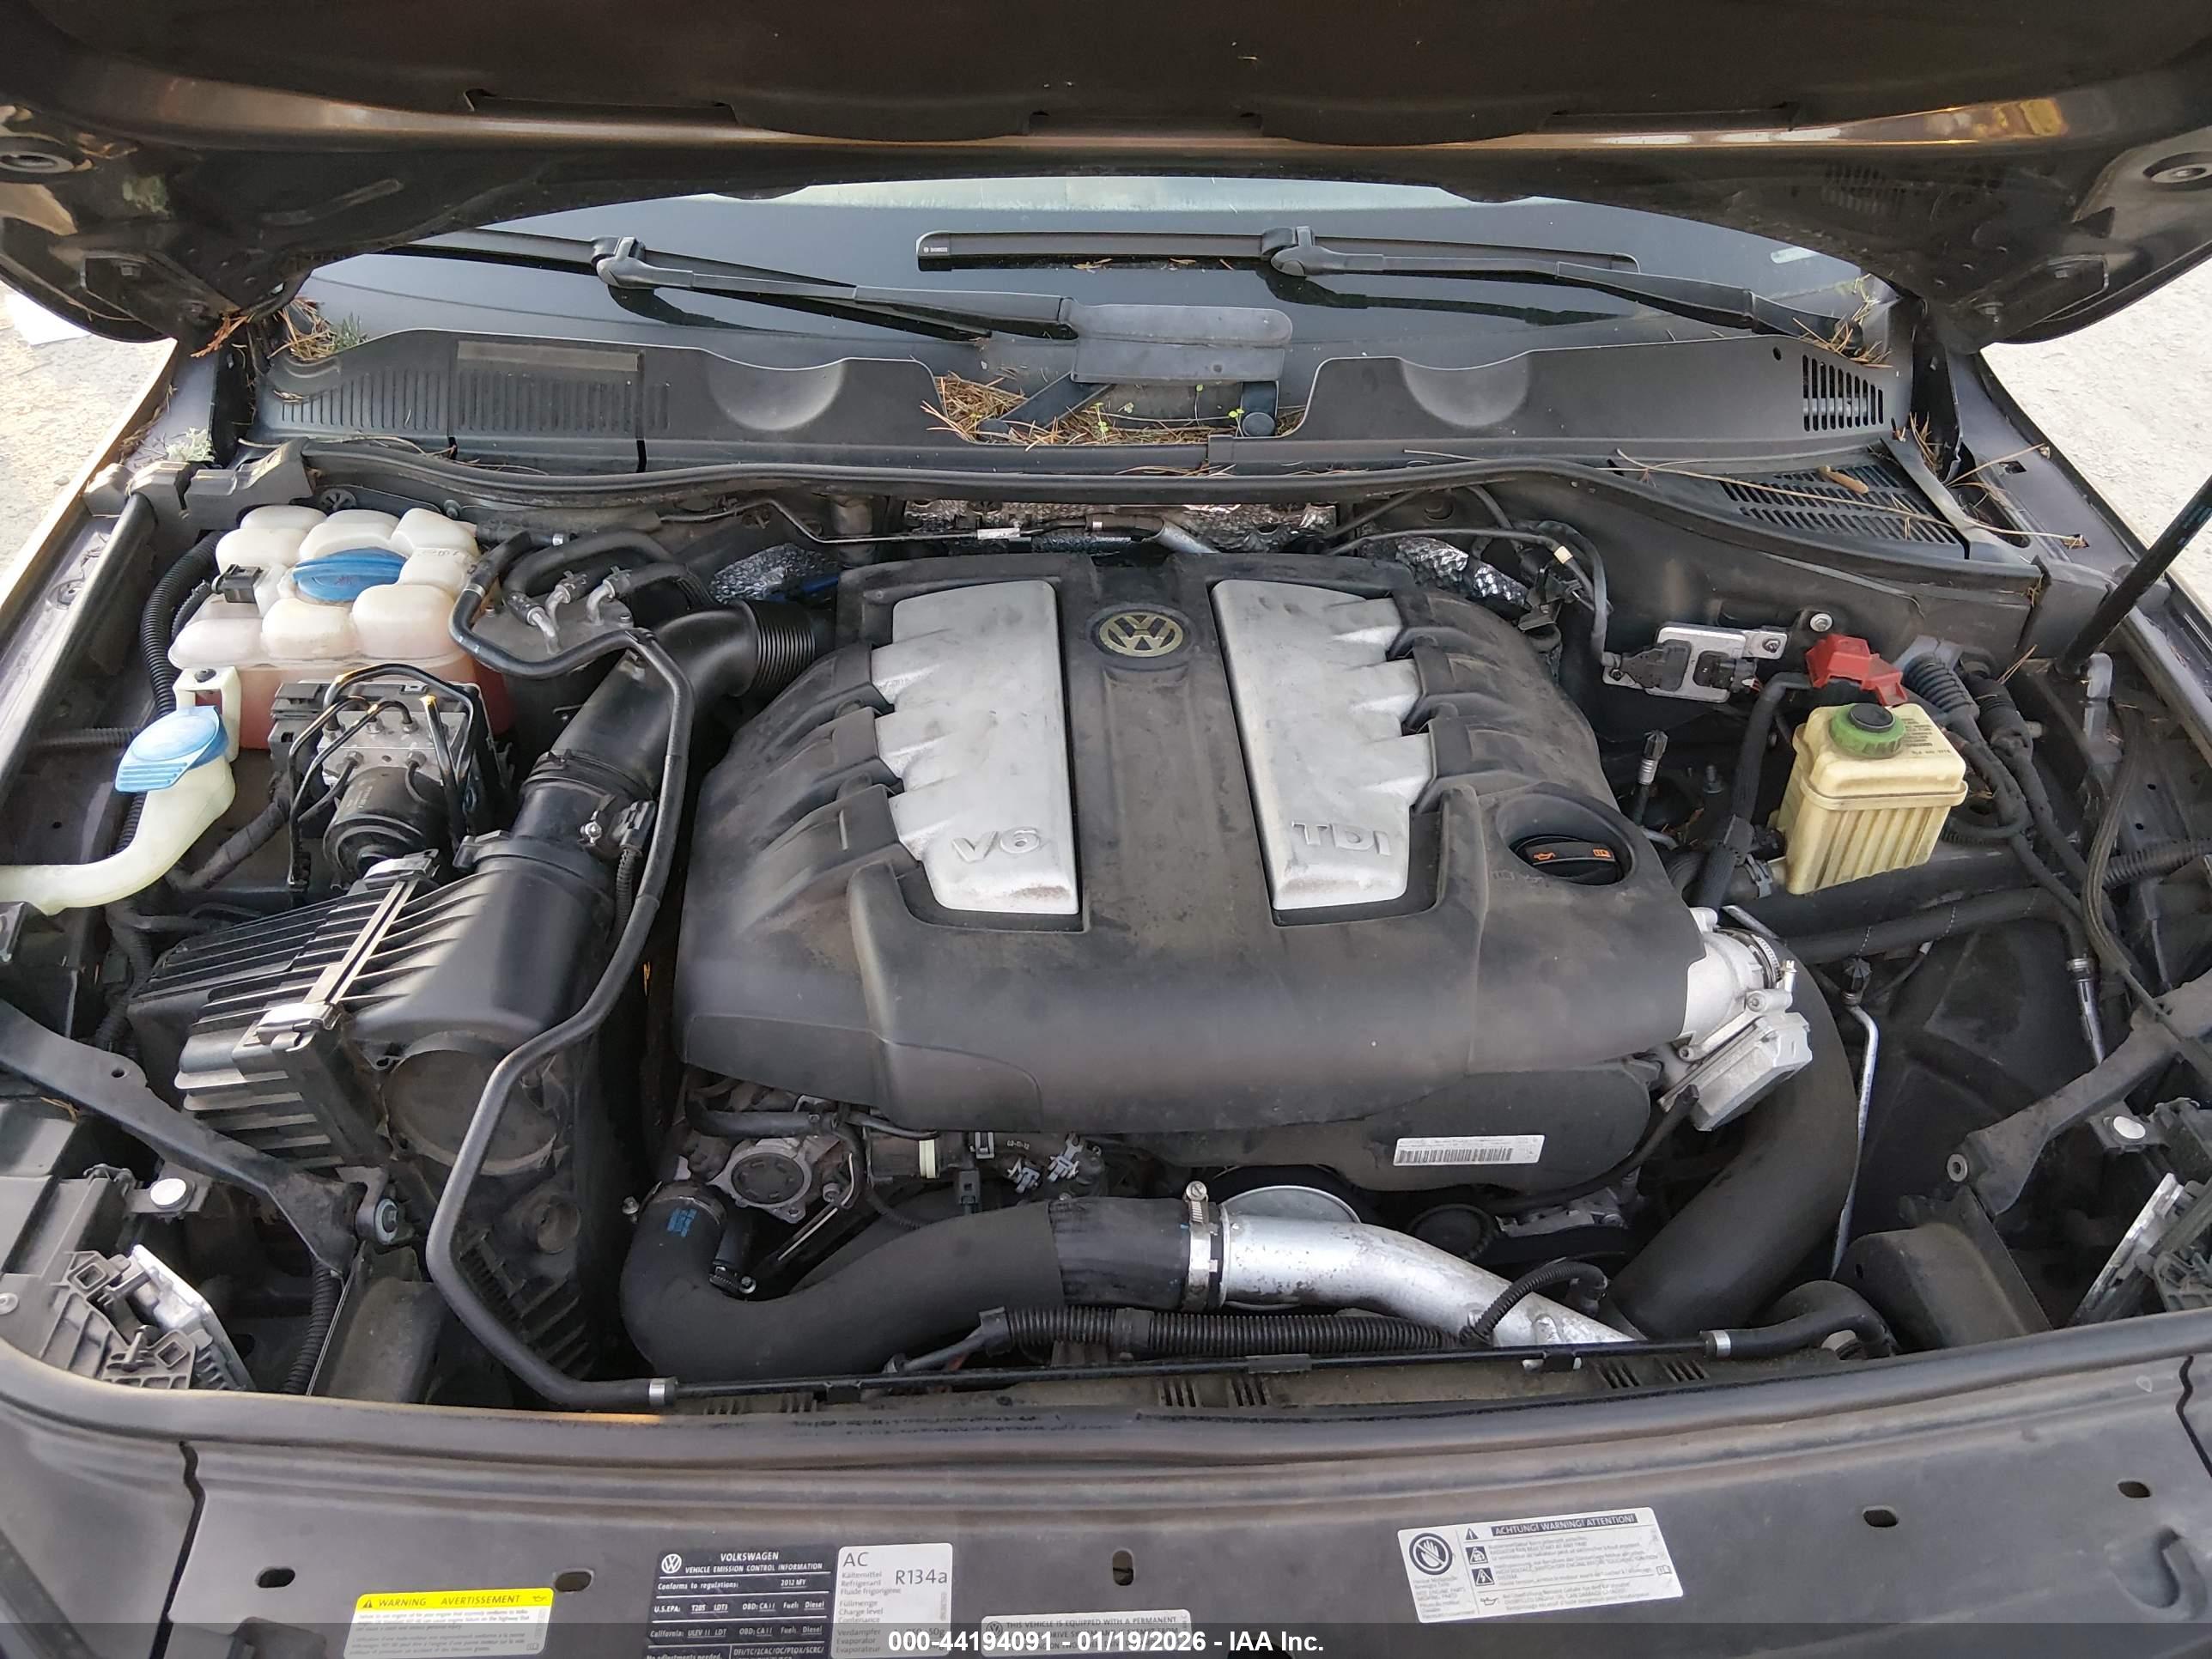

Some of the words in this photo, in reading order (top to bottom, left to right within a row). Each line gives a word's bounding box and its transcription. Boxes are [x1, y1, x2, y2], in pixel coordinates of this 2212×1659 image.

[1291, 820, 1391, 856] TDI
[950, 826, 1041, 864] V6
[1495, 1523, 1540, 1535] ACHTUNG!
[1540, 1519, 1584, 1530] WARNING!
[1586, 1515, 1634, 1526] ATTENTION!
[720, 1552, 779, 1562] VOLKSWAGEN
[842, 1552, 869, 1567] AC
[685, 1565, 710, 1574] VEHICLE
[714, 1565, 744, 1573] EMISSION
[746, 1564, 775, 1572] CONTROL
[778, 1563, 823, 1571] INFORMATION
[895, 1568, 948, 1585] R134a
[700, 1581, 739, 1590] regulations:
[842, 1579, 881, 1589] Refrigerant
[378, 1597, 427, 1607] WARNING
[441, 1595, 522, 1606] AVERTISSEMENT
[742, 1602, 758, 1611] OBD:
[839, 1608, 865, 1617] Charge
[1065, 1619, 1101, 1627] EQUIPPED
[1133, 1615, 1176, 1624] PERMANENT
[836, 1637, 876, 1646] Evaporator
